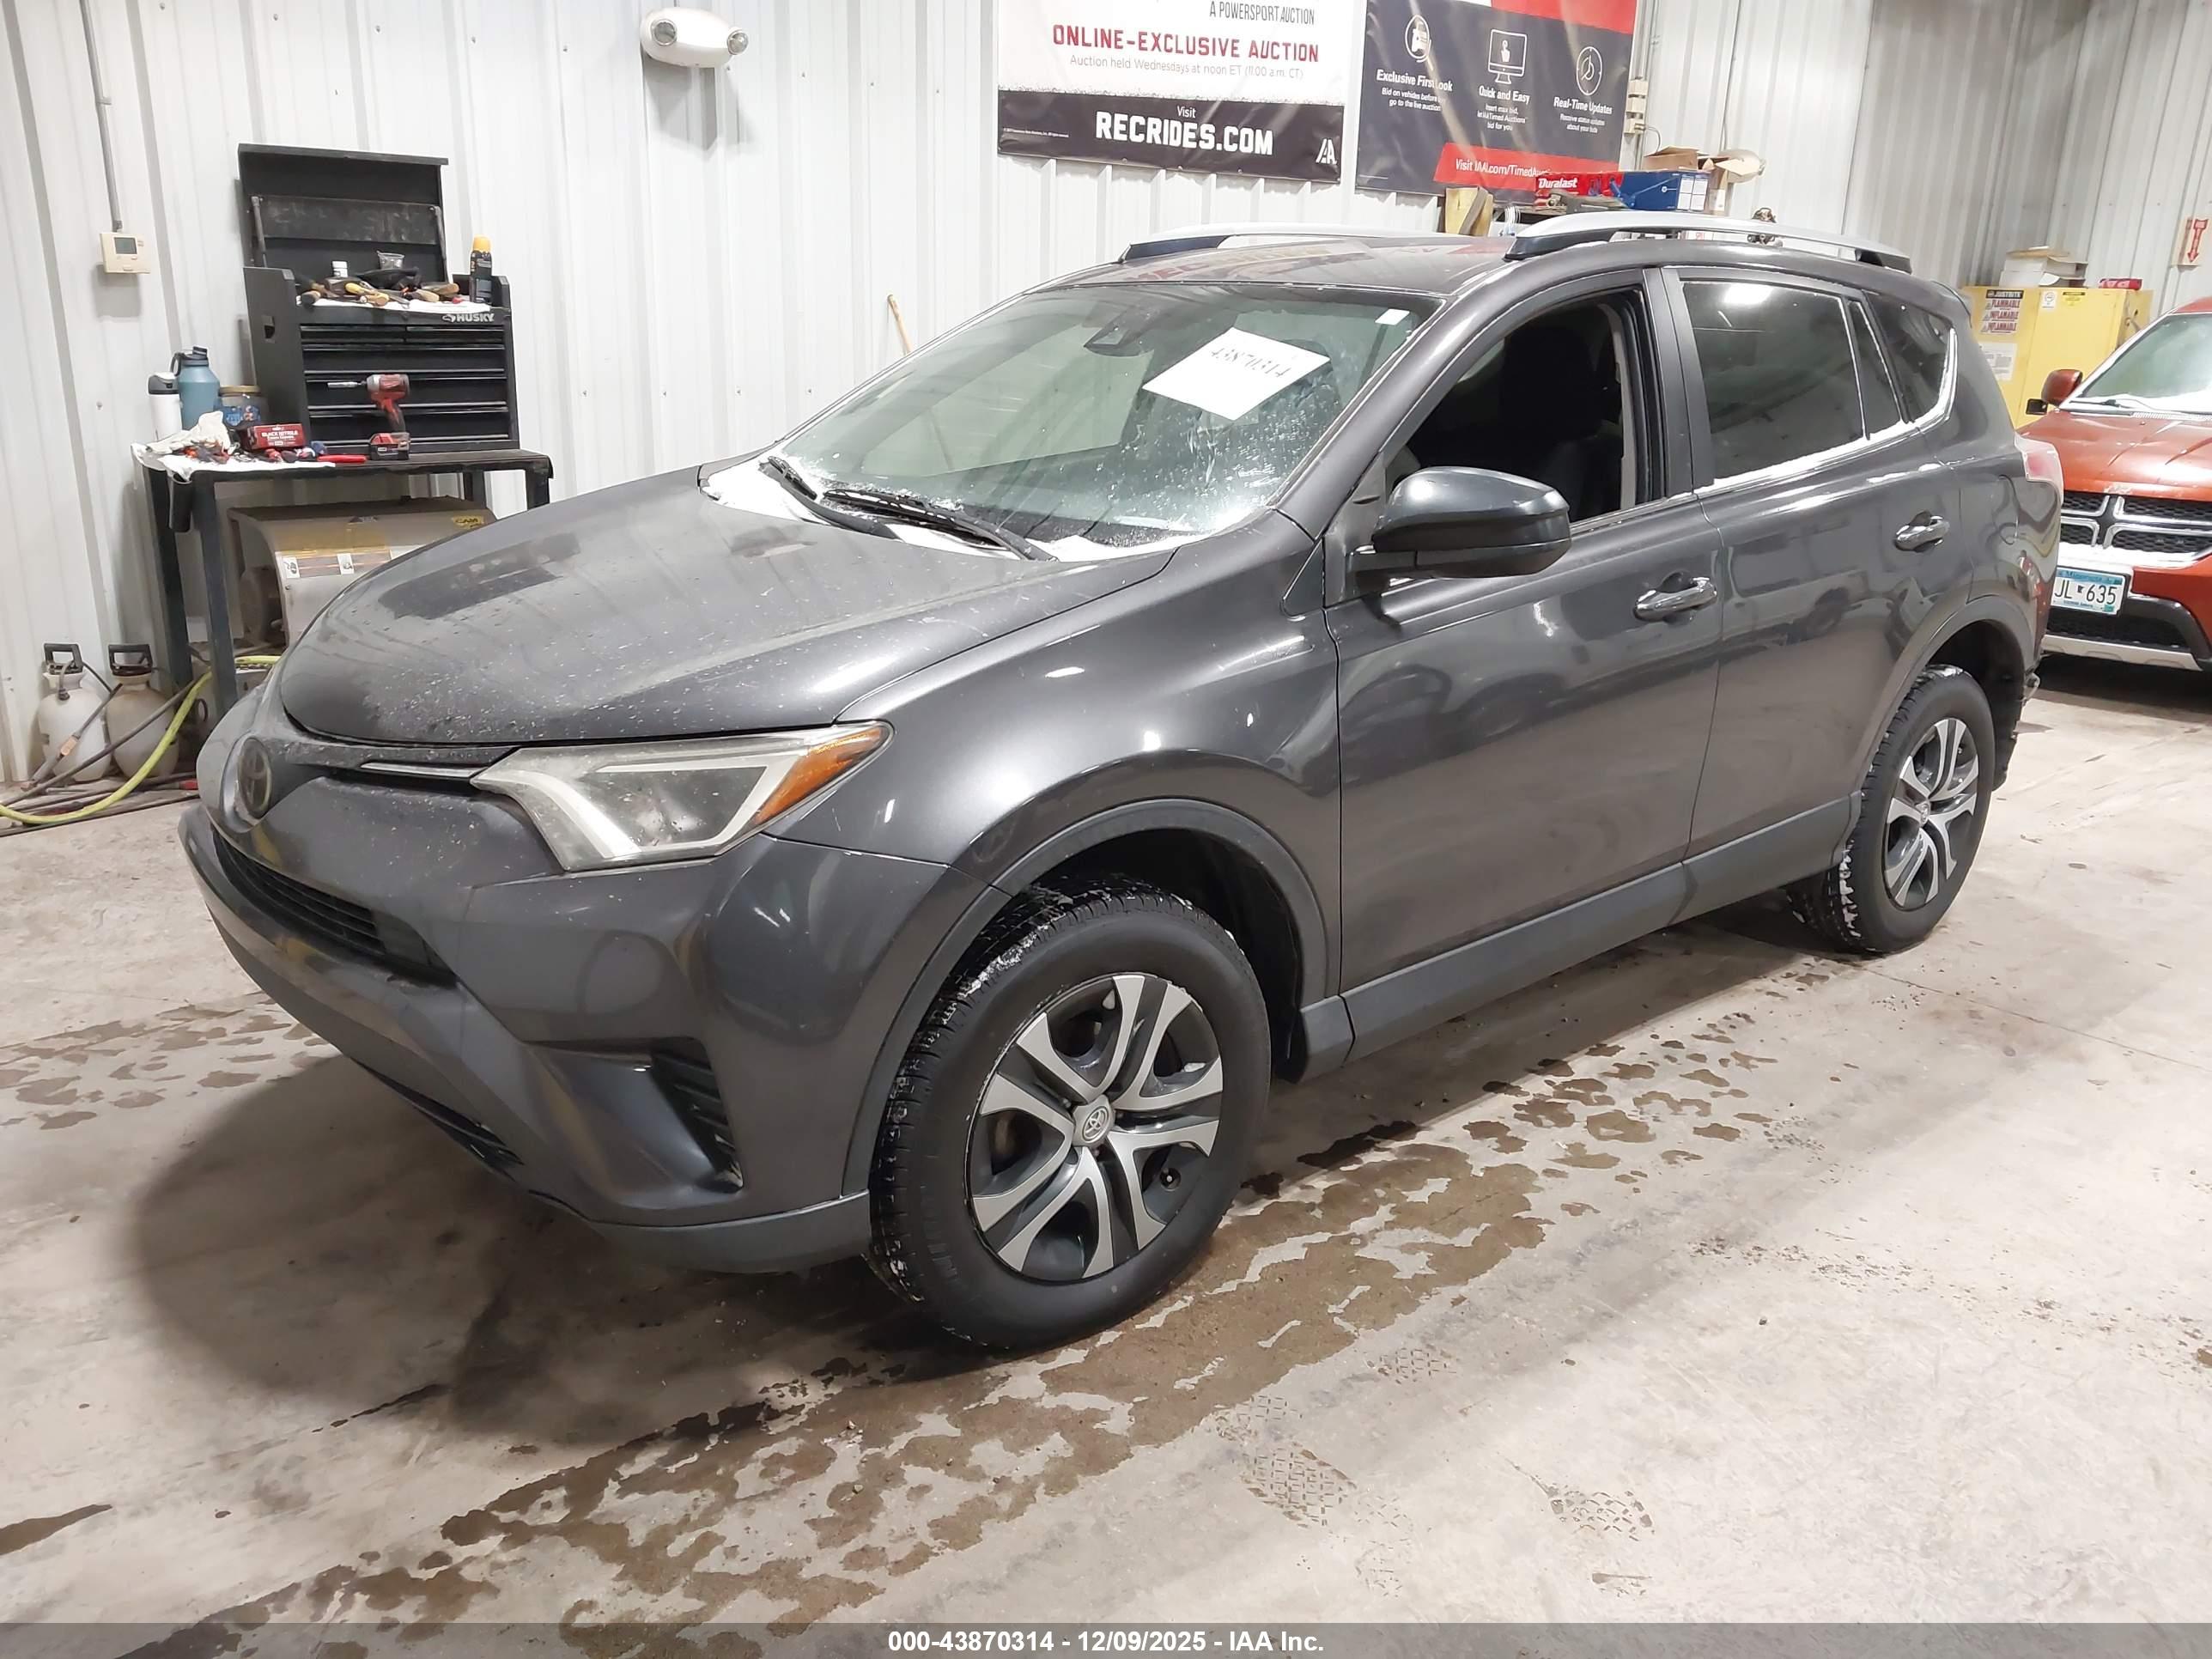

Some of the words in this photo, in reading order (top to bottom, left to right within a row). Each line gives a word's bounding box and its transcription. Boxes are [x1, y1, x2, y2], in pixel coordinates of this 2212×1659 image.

[1209, 1, 1217, 17] A
[1219, 2, 1279, 21] POWERSPORT
[1279, 7, 1315, 25] AUCTION
[1053, 24, 1240, 58] ONLINE-EXCLUSIVE
[1248, 40, 1319, 63] AUCTION
[1070, 54, 1108, 67] Auction
[1110, 57, 1131, 69] held
[1134, 58, 1189, 75] Wednesdays
[1191, 64, 1200, 74] at
[1203, 65, 1227, 76] noon
[1230, 65, 1242, 76] ET
[1289, 68, 1304, 79] CT)
[1376, 69, 1416, 85] Exclusive
[1382, 88, 1392, 96] Bid
[1479, 85, 1495, 99] Quick
[1497, 89, 1511, 100] and
[1512, 90, 1530, 105] Easy
[1176, 105, 1196, 118] Visit
[1389, 99, 1396, 107] go
[1553, 96, 1589, 111] Real-Time
[1589, 100, 1613, 115] Updates
[1095, 111, 1273, 155] RECRIDES.COM
[1455, 158, 1473, 172] Visit
[1538, 178, 1577, 189] Duralast
[456, 313, 495, 322] HUSKY
[2054, 580, 2073, 599] JL
[2086, 584, 2118, 605] 635
